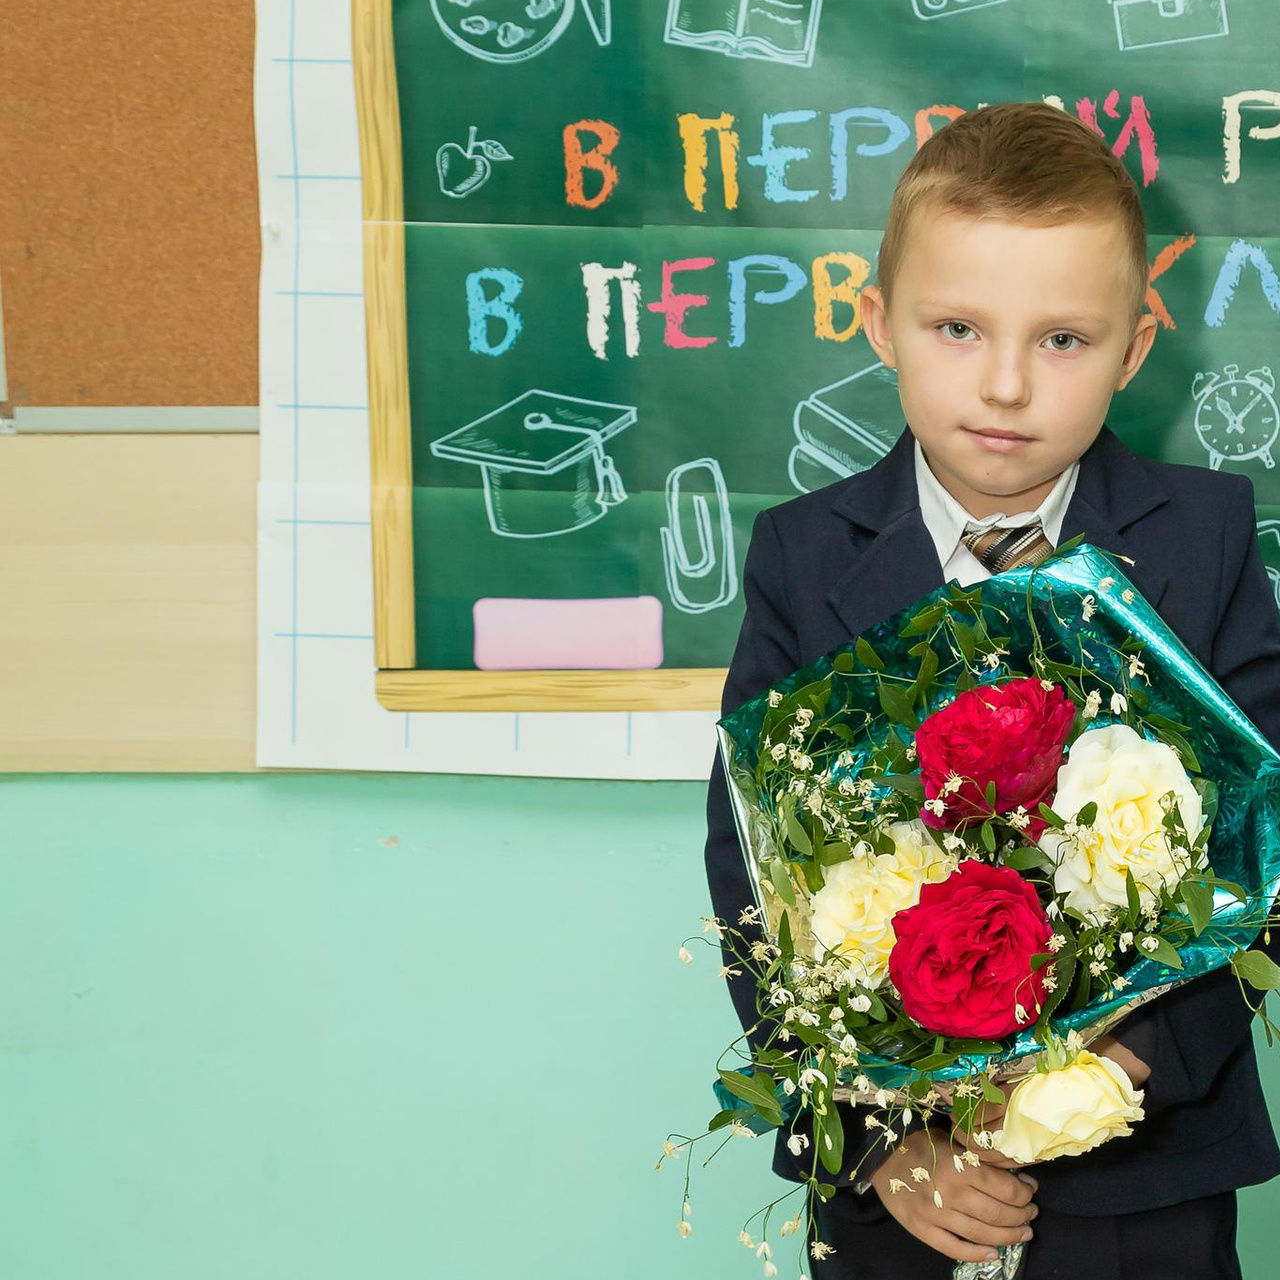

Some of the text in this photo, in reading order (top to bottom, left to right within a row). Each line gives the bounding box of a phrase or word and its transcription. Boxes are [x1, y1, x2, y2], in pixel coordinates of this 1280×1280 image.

[562, 119, 621, 210] В
[676, 89, 1160, 213] ПЕРЙ
[465, 267, 524, 357] В
[580, 251, 870, 361] ПЕРВ
